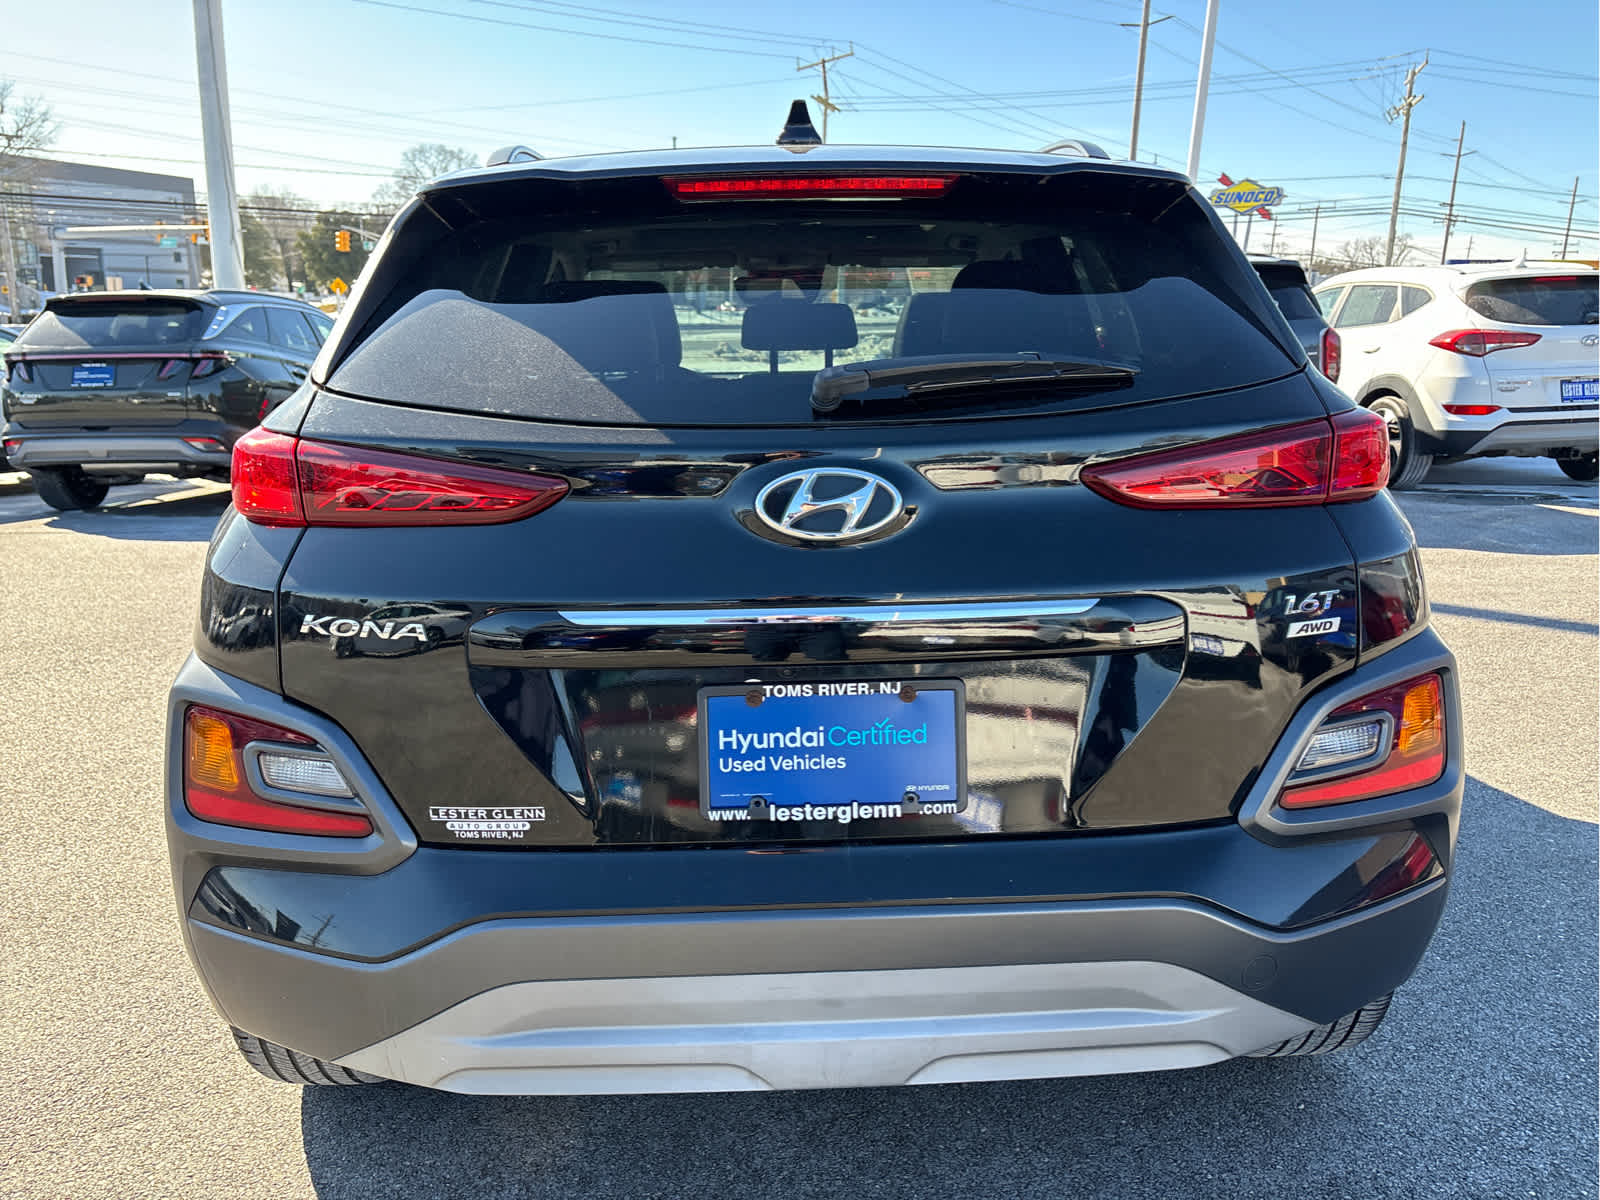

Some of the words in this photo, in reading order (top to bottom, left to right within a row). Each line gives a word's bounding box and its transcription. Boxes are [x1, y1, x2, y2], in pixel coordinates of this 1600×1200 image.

[1214, 190, 1274, 204] SUNOCO
[1562, 383, 1583, 397] LESTER
[1584, 382, 1599, 396] GLEN
[300, 614, 429, 642] KONA
[1296, 620, 1333, 635] AWD
[763, 684, 813, 698] TOMS
[818, 683, 875, 697] RIVER,
[880, 682, 901, 695] NJ
[718, 726, 825, 754] Hyundai
[827, 718, 928, 746] Certified
[719, 756, 766, 773] Used
[769, 753, 847, 771] Vehicles
[429, 808, 487, 819] LESTER
[492, 808, 546, 819] GLENN
[708, 809, 751, 821] www.
[770, 803, 902, 823] lesterglenn
[919, 802, 957, 815] .com
[455, 831, 479, 839] TOMS
[482, 831, 511, 840] RIVER,
[512, 831, 524, 839] NJ
